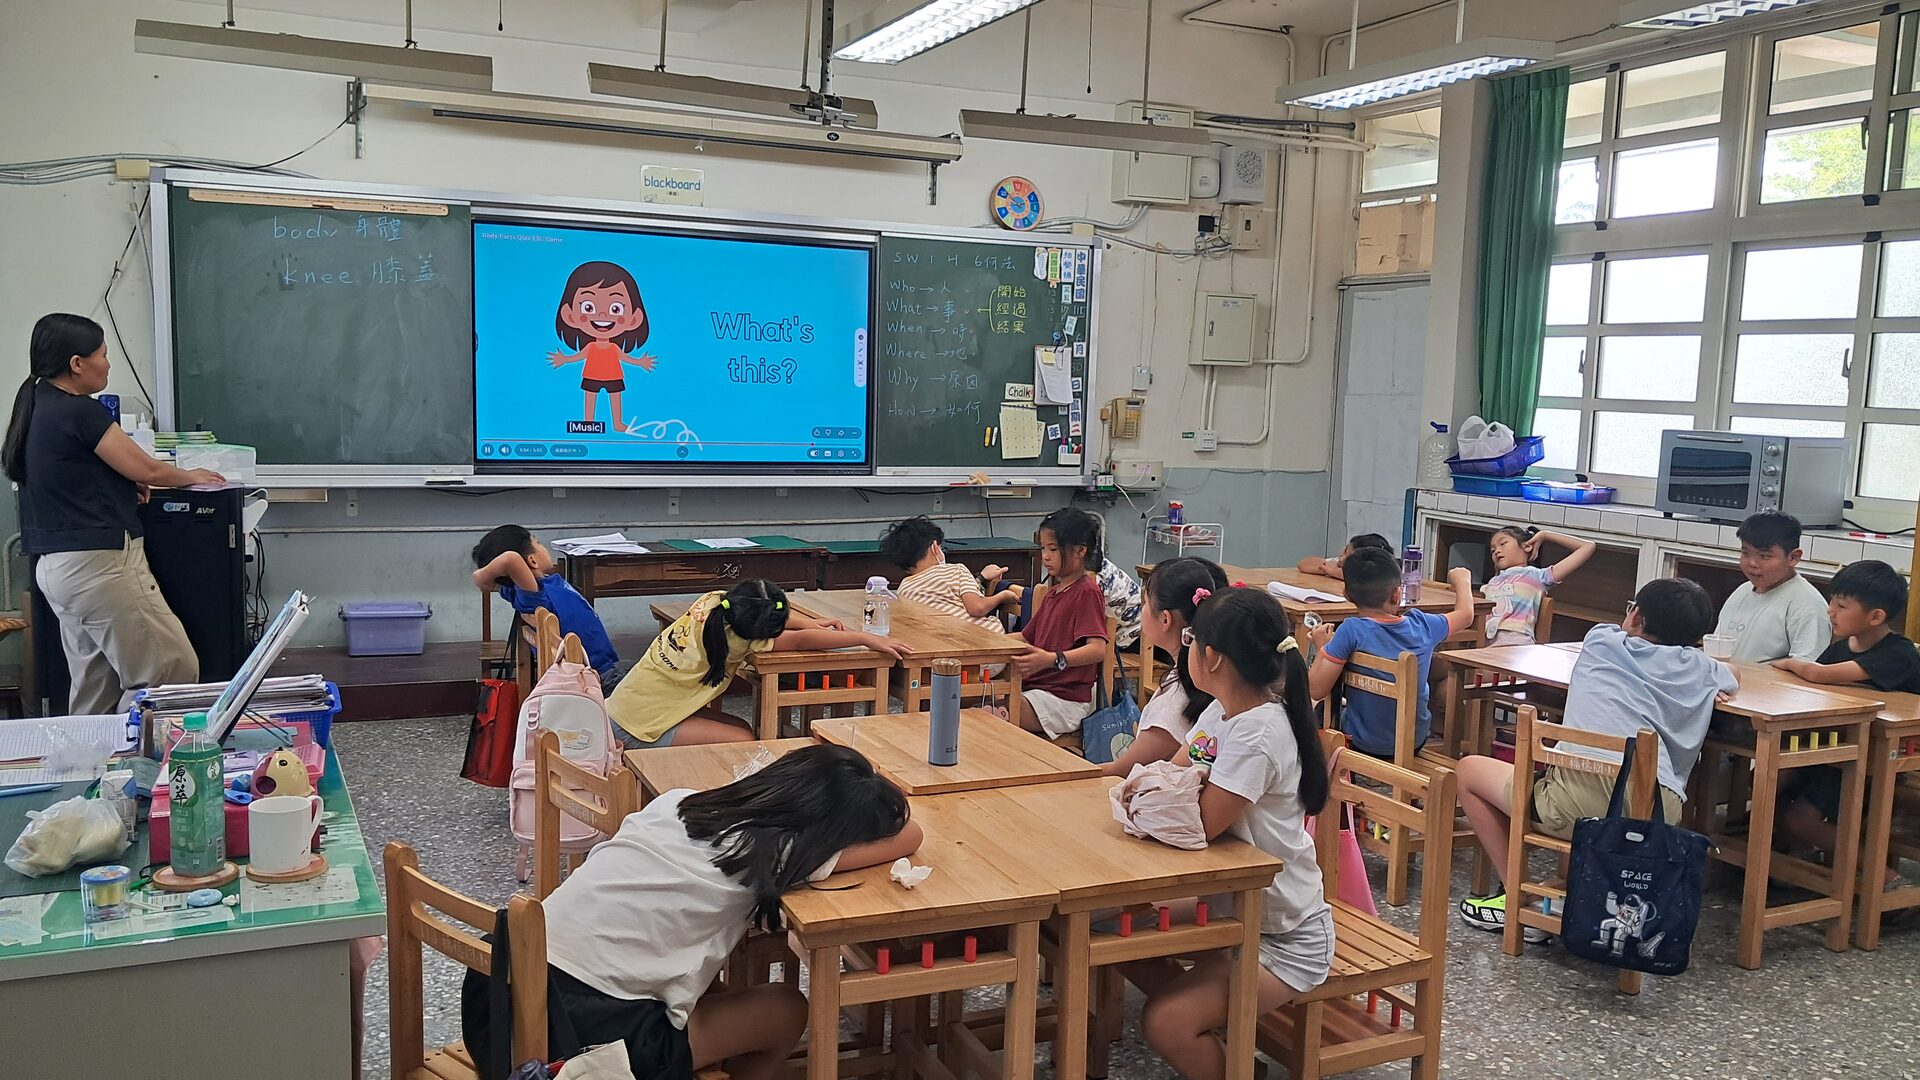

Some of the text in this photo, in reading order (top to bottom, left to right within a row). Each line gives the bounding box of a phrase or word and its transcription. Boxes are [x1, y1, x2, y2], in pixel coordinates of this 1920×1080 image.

[644, 175, 701, 191] blackboard
[355, 215, 402, 242] 身體
[283, 253, 434, 286] knee 膝蓋
[1075, 251, 1087, 300] 中華民國
[889, 279, 951, 293] Who 人
[997, 284, 1027, 299] 開始
[886, 299, 956, 323] What 事
[996, 302, 1027, 318] 經過
[710, 311, 815, 344] What's
[887, 322, 924, 335] When
[996, 320, 1026, 334] 結果
[886, 343, 927, 359] Where
[1075, 343, 1084, 355] 月
[727, 355, 798, 385] this?
[888, 370, 919, 393] Why
[1008, 385, 1031, 399] Chalk
[569, 421, 603, 433] [Music]
[171, 764, 188, 807] 原萃
[1620, 869, 1653, 881] SPACE
[1623, 880, 1649, 890] WORLD
